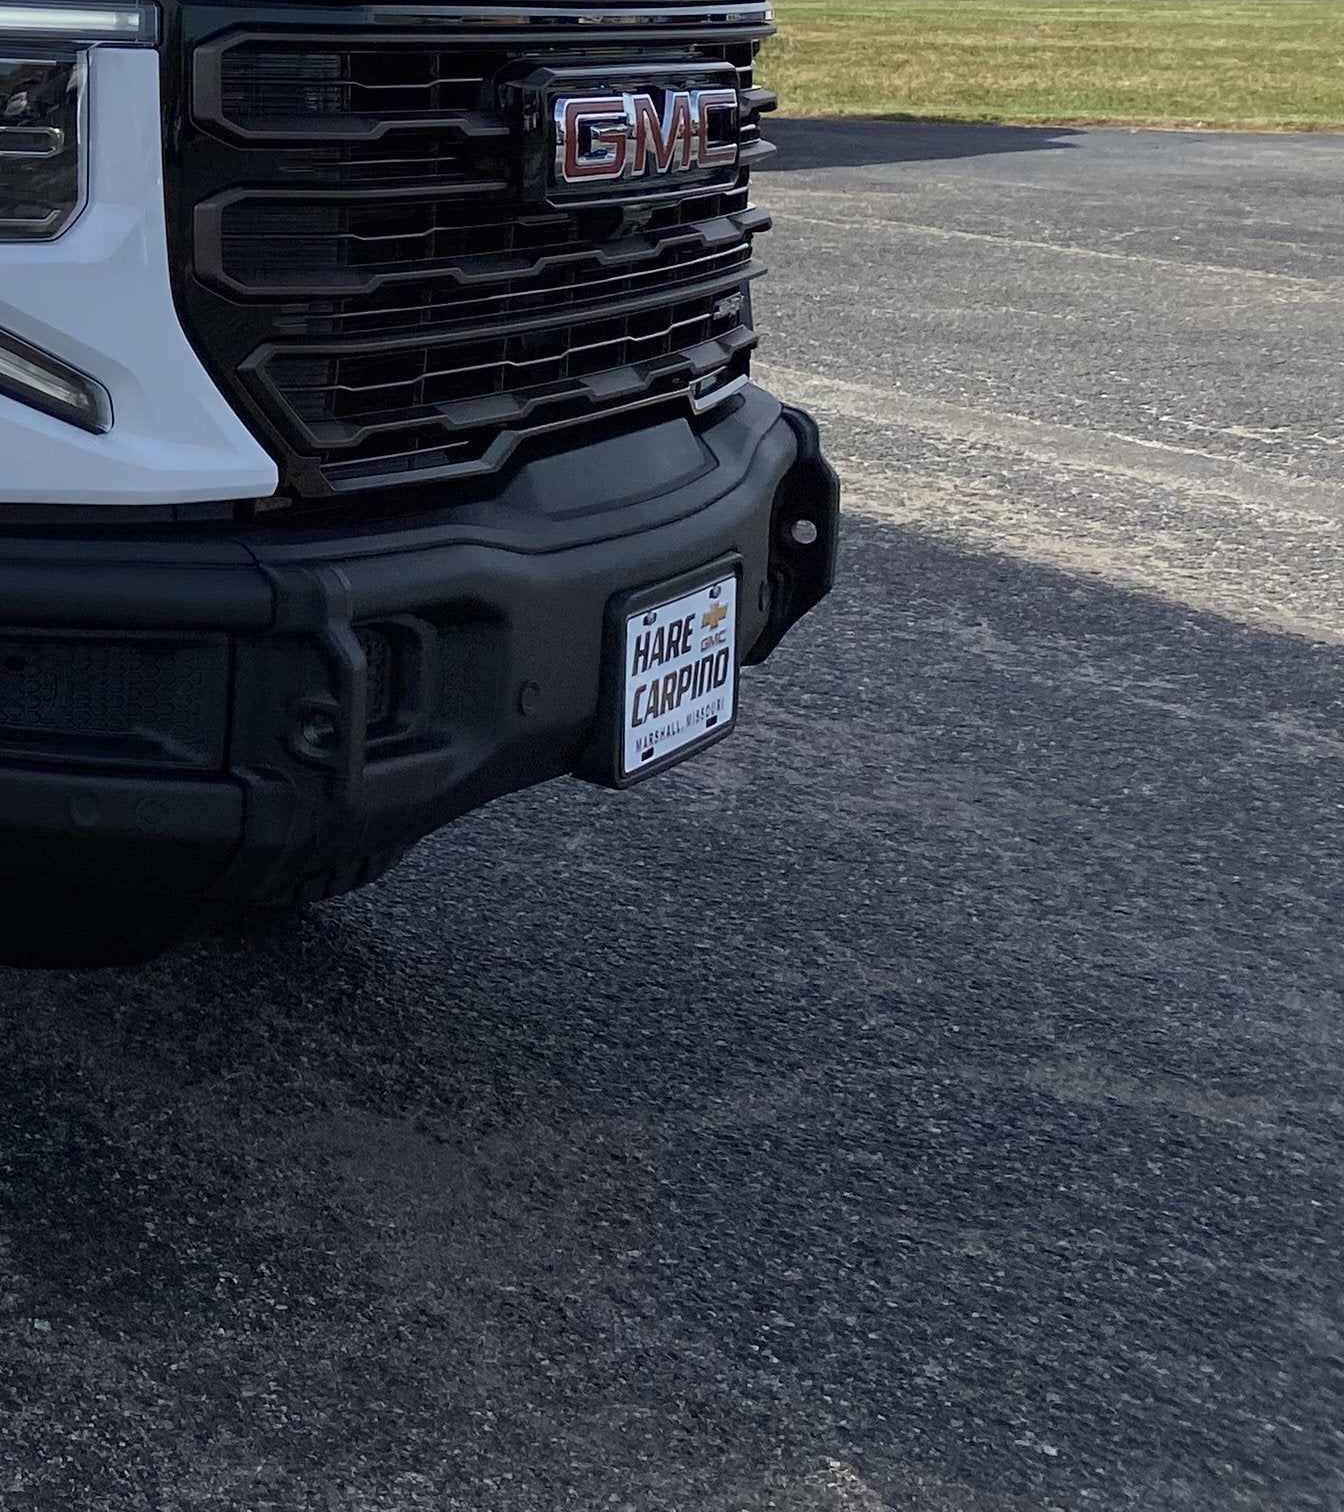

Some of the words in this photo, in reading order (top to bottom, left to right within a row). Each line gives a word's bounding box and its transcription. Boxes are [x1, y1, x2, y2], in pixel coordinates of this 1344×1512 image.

[554, 88, 738, 183] GMC
[631, 613, 696, 677] HARE
[700, 629, 727, 652] GMC
[631, 646, 729, 728] CARPINO
